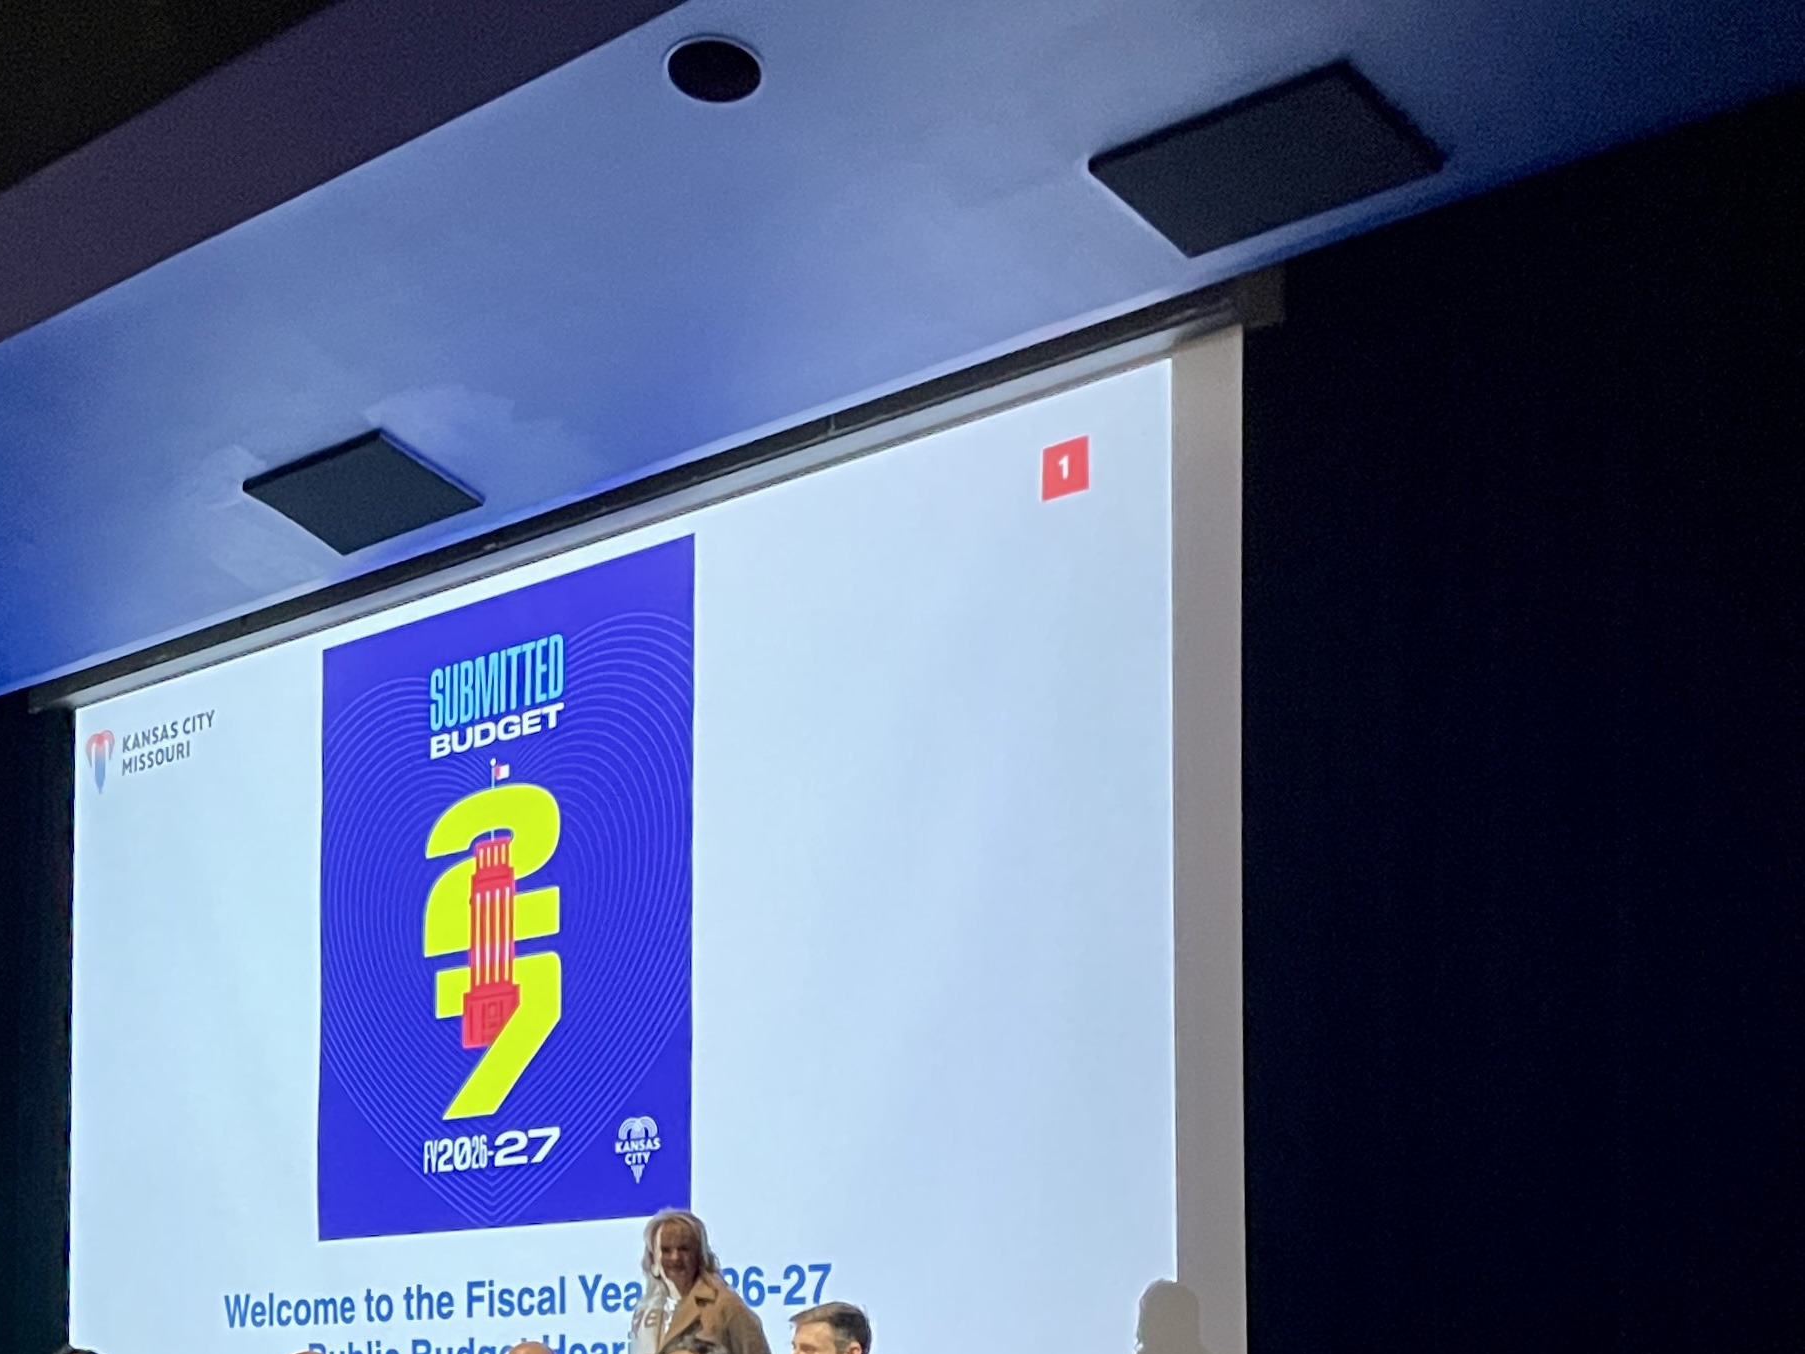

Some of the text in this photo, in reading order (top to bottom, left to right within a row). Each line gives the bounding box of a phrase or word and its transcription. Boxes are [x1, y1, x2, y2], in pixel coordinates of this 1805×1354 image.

[1058, 454, 1070, 480] 1
[429, 633, 564, 732] SUBMITTED
[122, 709, 215, 753] KANSAS CITY
[429, 702, 565, 760] BUDGET
[121, 740, 191, 776] MISSOURI
[423, 1125, 561, 1175] FY2026-27
[614, 1136, 661, 1154] KANSAS
[624, 1151, 651, 1166] CITY
[224, 1263, 832, 1329] Welcome to the Fiscal Yea 6-27
